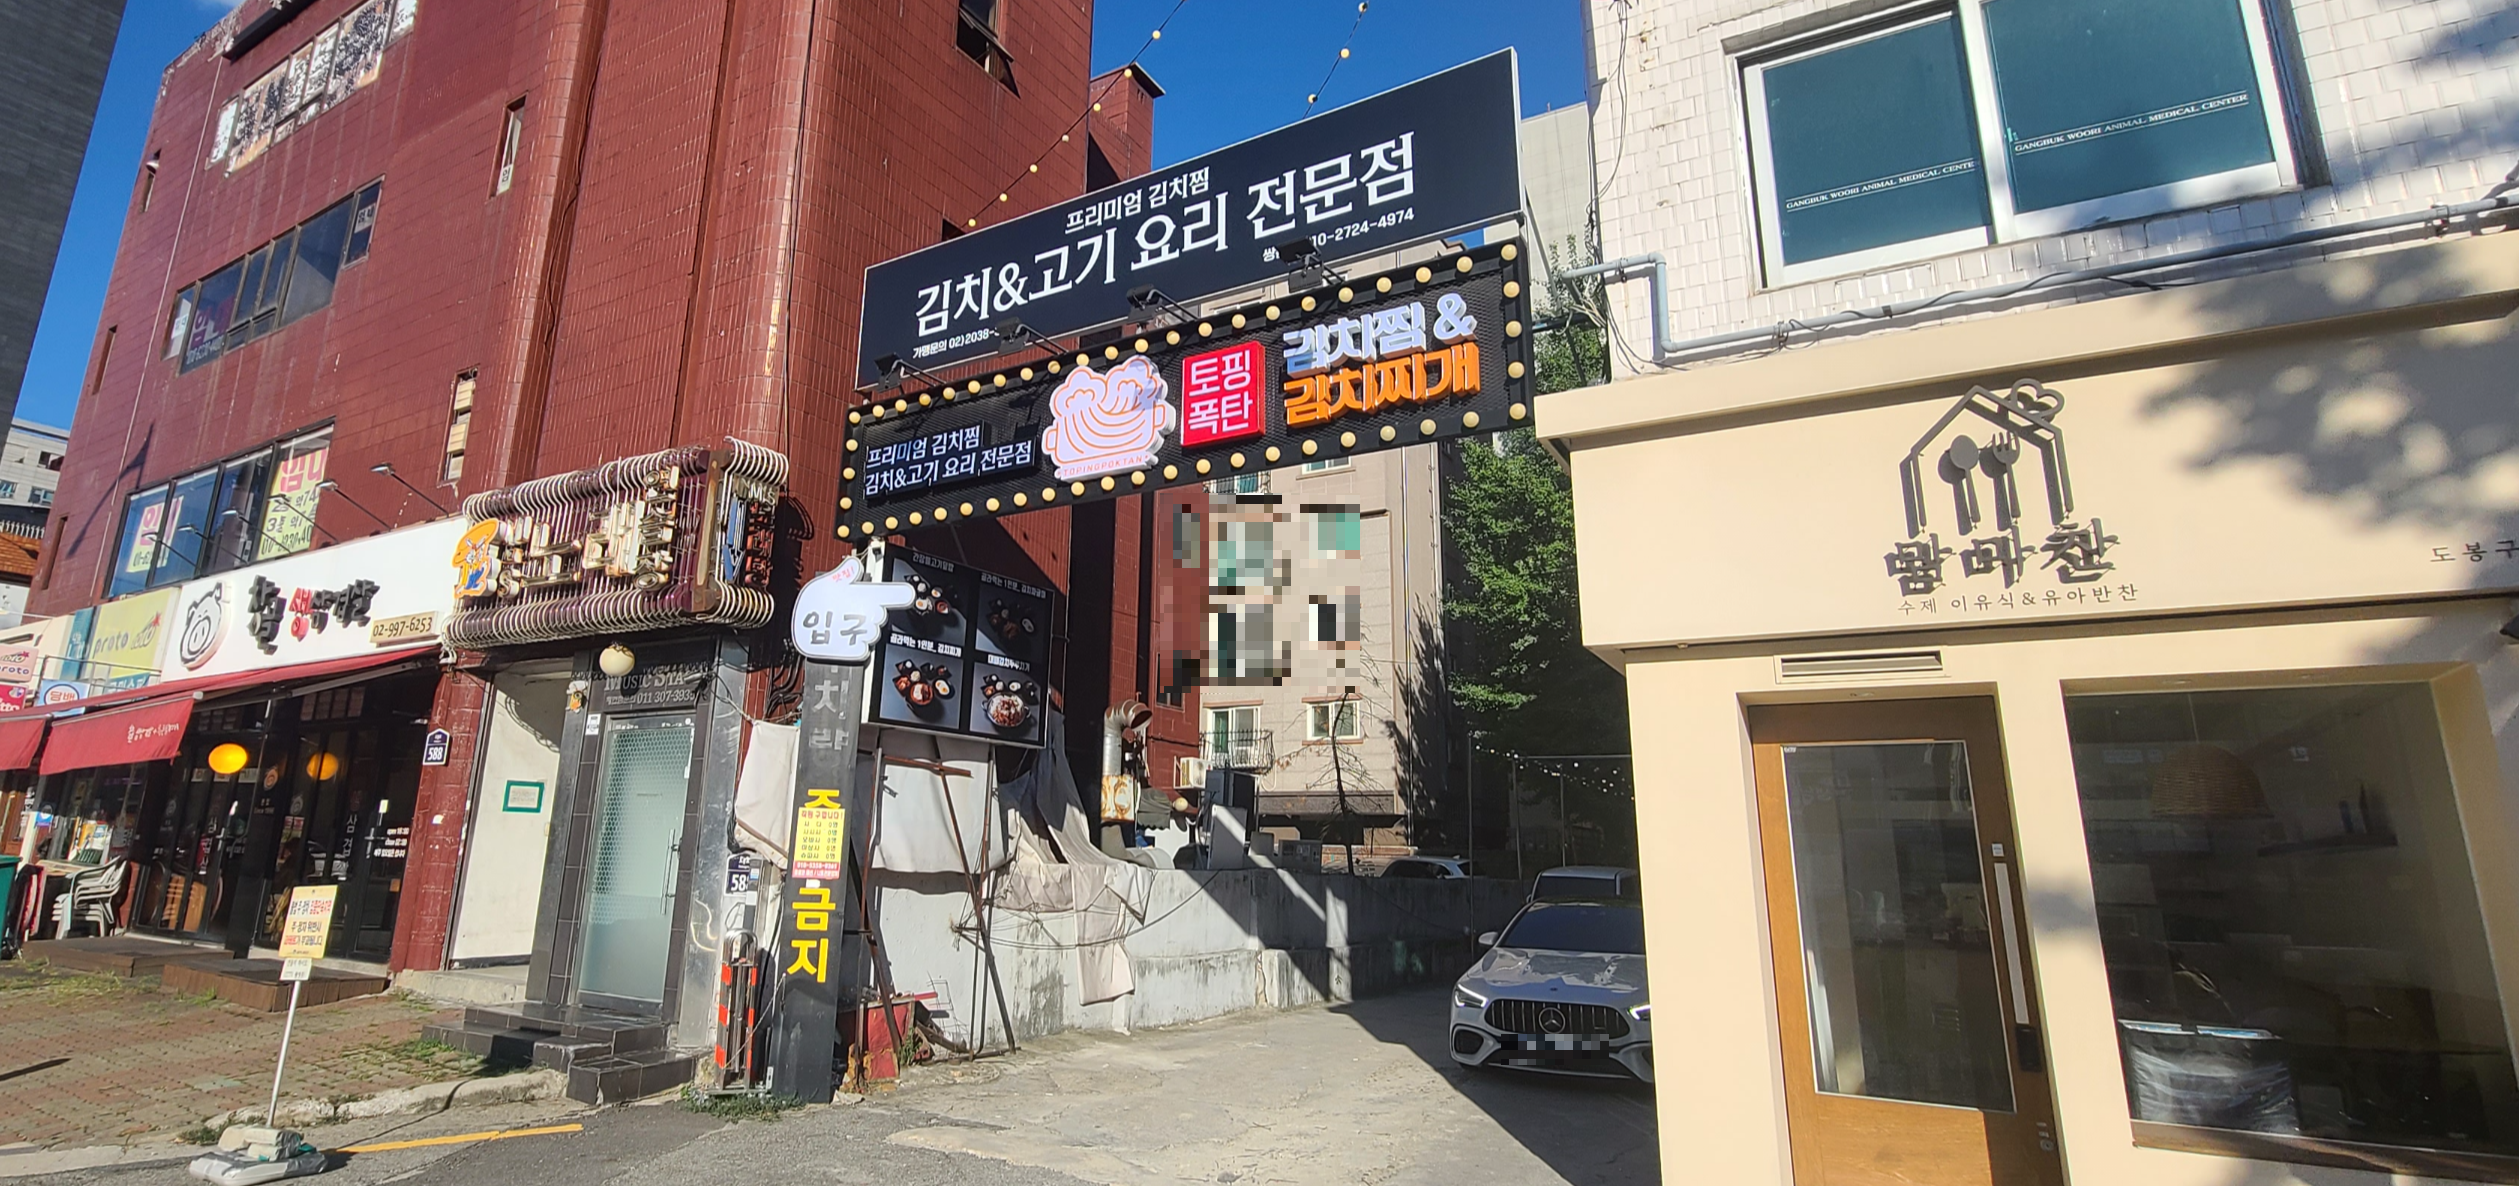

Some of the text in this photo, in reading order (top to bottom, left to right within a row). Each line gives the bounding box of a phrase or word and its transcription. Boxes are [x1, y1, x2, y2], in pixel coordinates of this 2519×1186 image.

[2014, 92, 2249, 152] GANGBUK WOORI ANIMAL MEDICAL CENTER
[1065, 167, 1211, 235] 프리미엄 김치찜
[1786, 160, 1980, 209] GANGBUK WOORI ANIMAL MEDICAL CENTE
[915, 131, 1415, 337] 김치&고기 요리 전문점
[1309, 207, 1415, 247] 10-2724-4974
[912, 338, 948, 359] 가맹문의
[1283, 292, 1478, 377] 김치찜 &
[1189, 349, 1251, 397] 토핑
[1283, 342, 1480, 427] 김치찌개
[1188, 391, 1253, 435] 폭탄
[865, 440, 1033, 496] 김치&고기 요리 전문점
[866, 425, 981, 469] 프리미엄 김치찜
[1062, 455, 1144, 477] TOPINGPOKTAN
[1885, 518, 2120, 597] 맘마찬
[2429, 539, 2519, 563] 도봉구
[1898, 583, 2140, 616] 수제 이유식&유아반찬
[93, 633, 130, 660] proto
[372, 616, 433, 638] 02-997-6253
[802, 610, 868, 646] 입구
[0, 665, 30, 675] roto
[427, 746, 444, 761] 588
